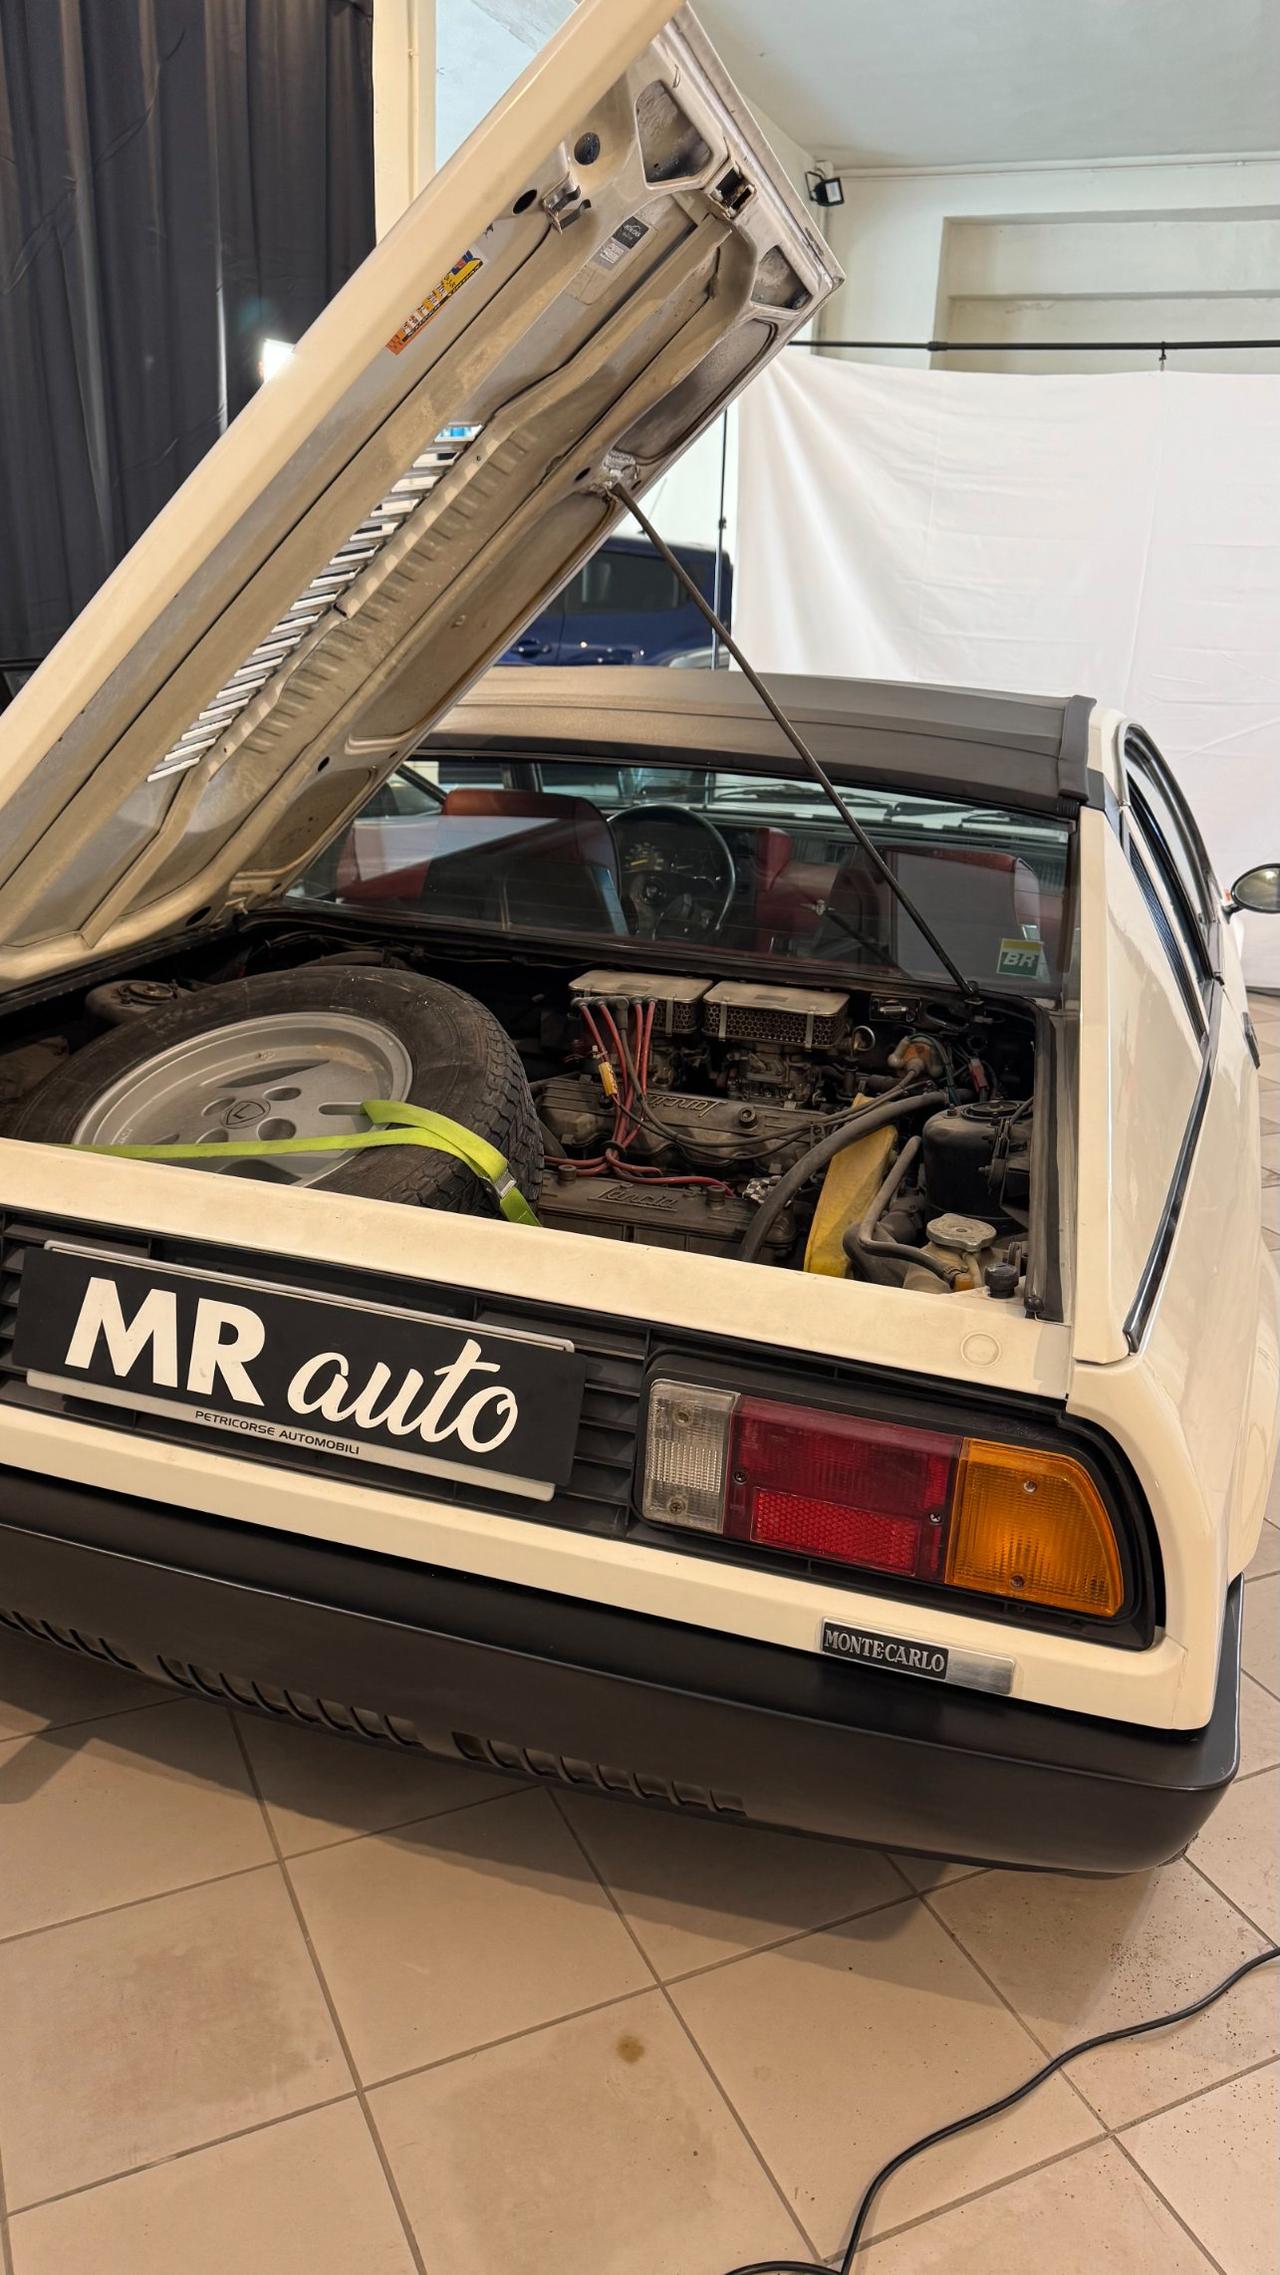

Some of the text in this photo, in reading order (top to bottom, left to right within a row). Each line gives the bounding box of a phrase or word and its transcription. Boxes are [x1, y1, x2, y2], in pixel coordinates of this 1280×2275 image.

[1003, 951, 1034, 968] BR
[64, 1276, 519, 1453] MR auto
[195, 1410, 359, 1455] PETRICORSE AUTOMOBILI
